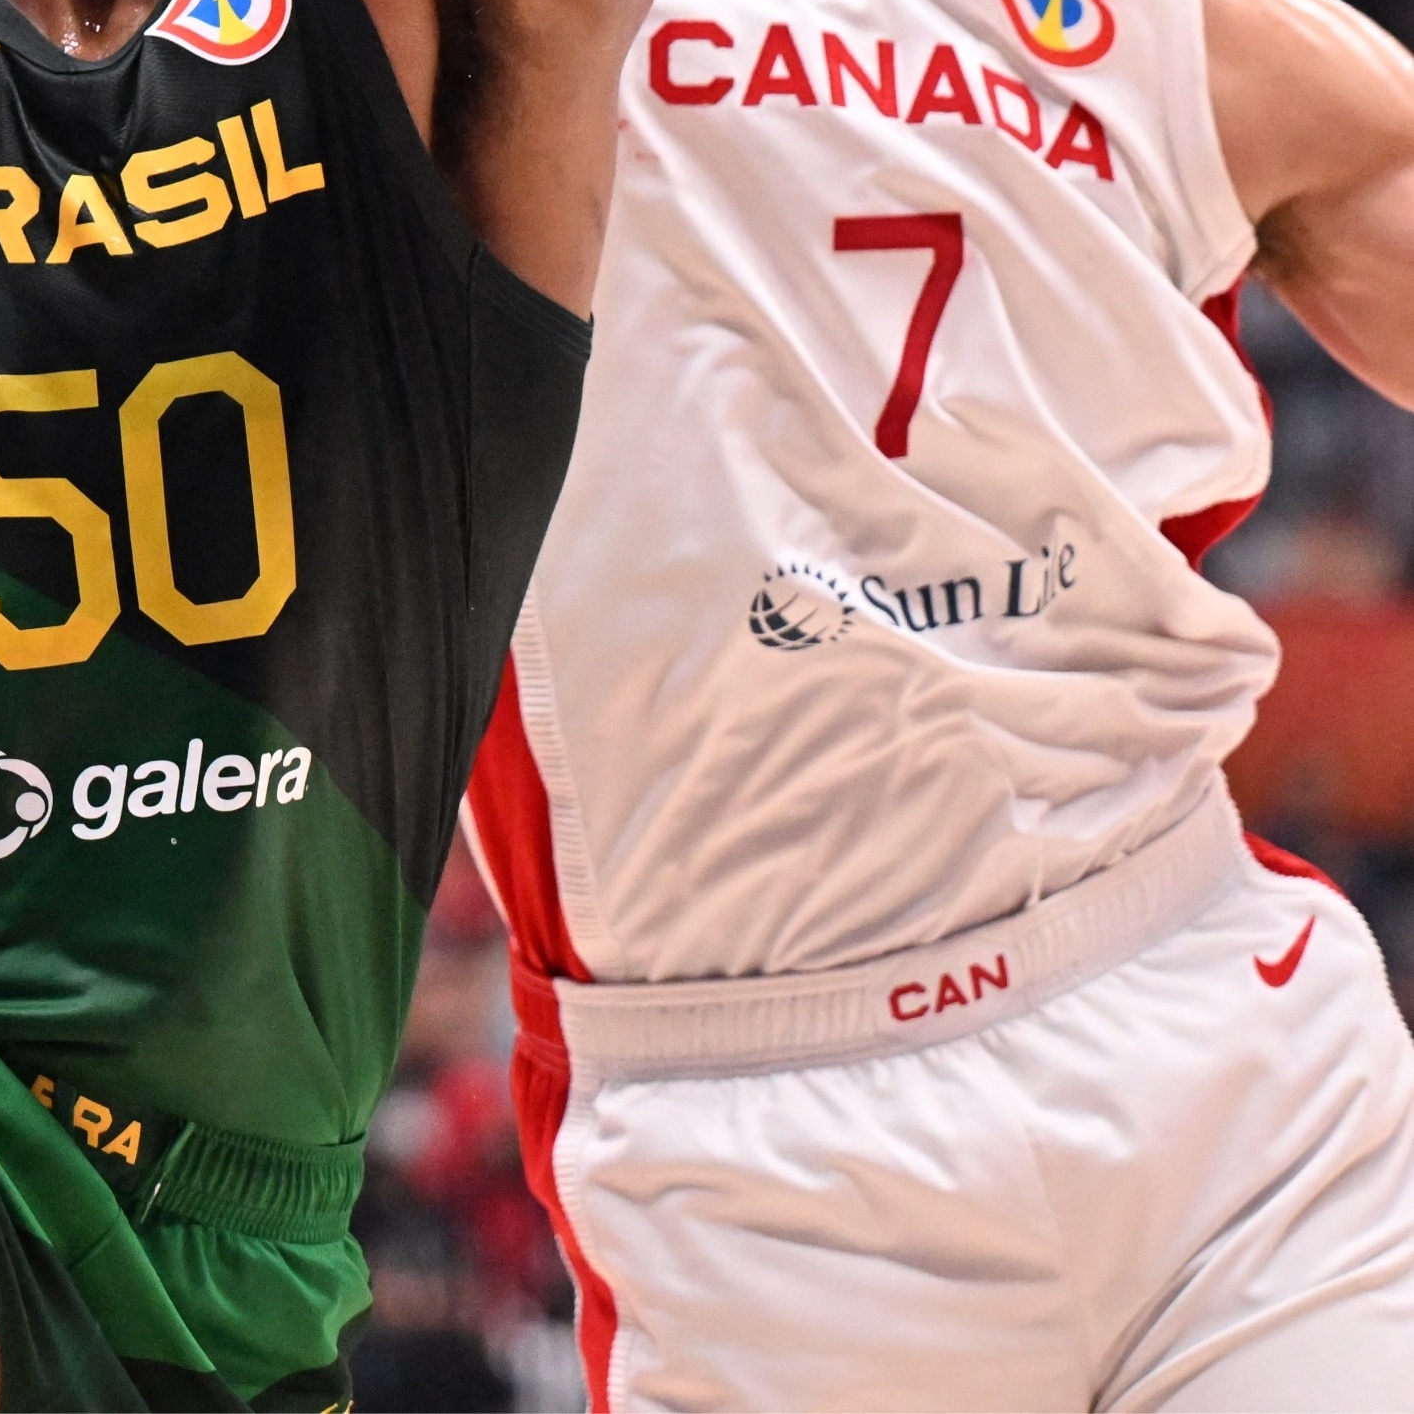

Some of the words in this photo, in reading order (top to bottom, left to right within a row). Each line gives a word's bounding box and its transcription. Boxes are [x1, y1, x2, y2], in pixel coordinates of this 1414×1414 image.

[649, 21, 1115, 183] CANADA
[833, 212, 965, 460] 7
[860, 573, 983, 633] Sun
[71, 738, 312, 841] galera
[888, 953, 1010, 1023] CAN
